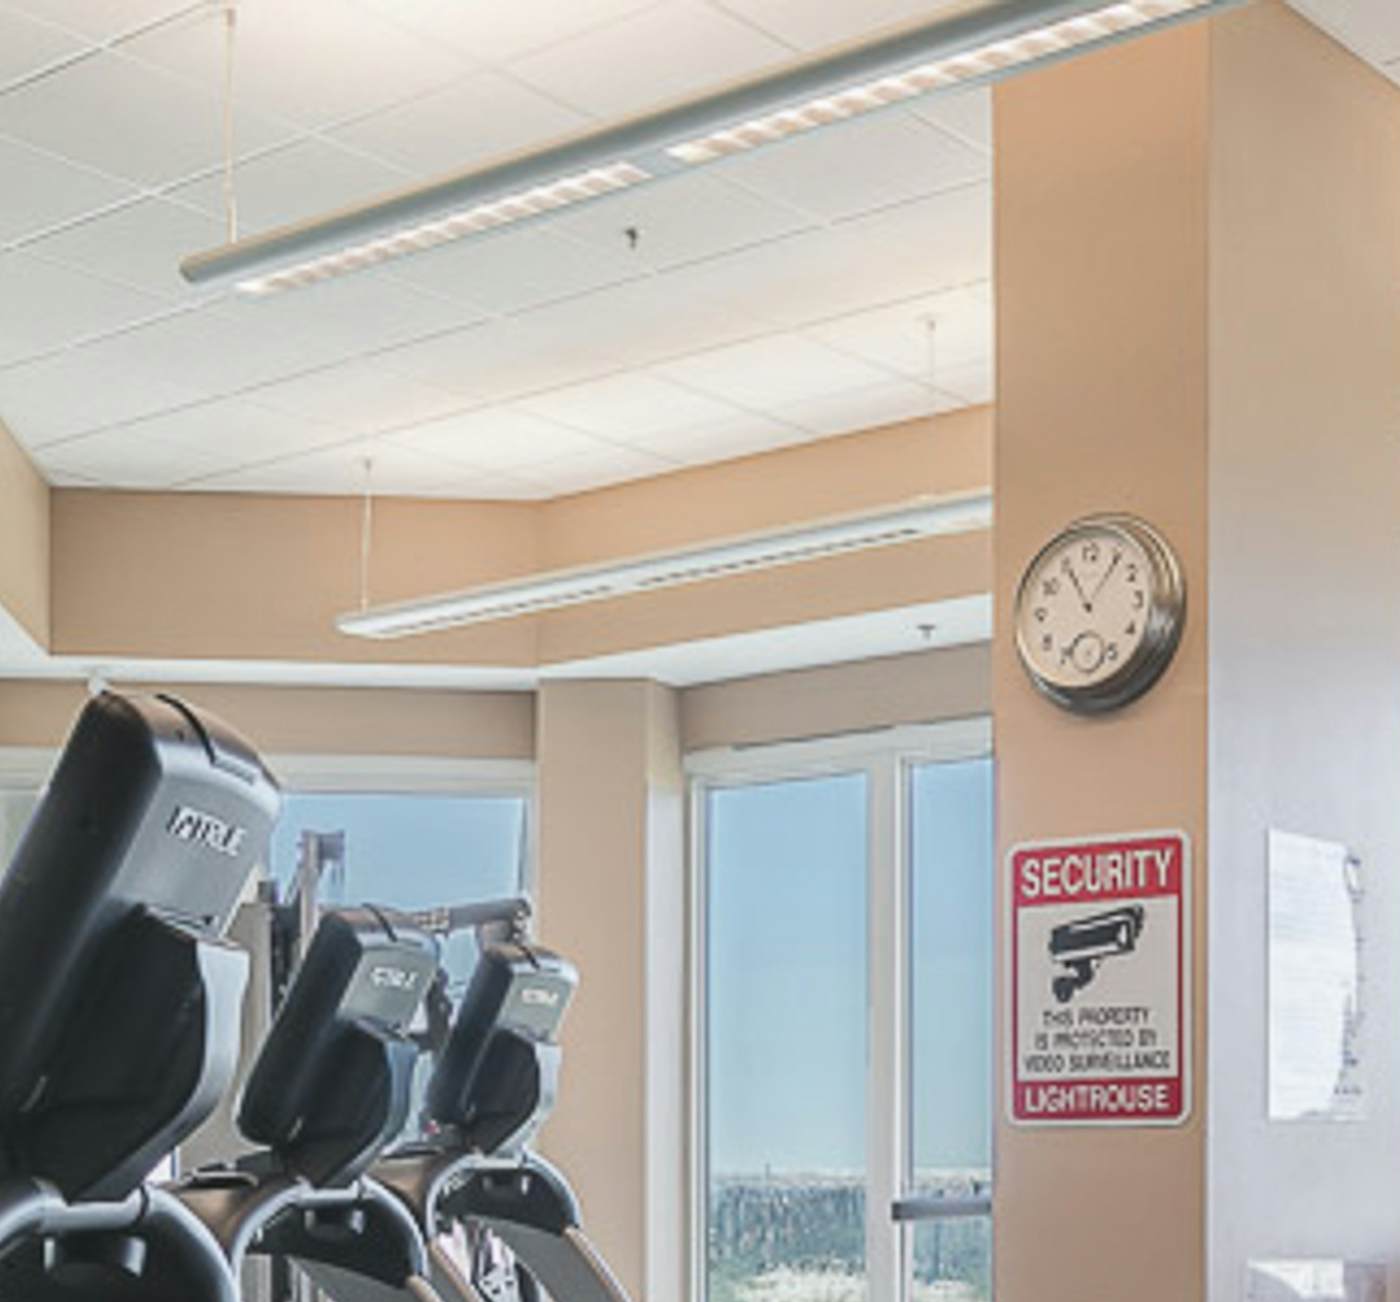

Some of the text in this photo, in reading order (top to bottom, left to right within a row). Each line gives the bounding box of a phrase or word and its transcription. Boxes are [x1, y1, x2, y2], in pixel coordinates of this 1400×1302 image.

[1083, 543, 1098, 562] 12
[1127, 563, 1137, 582] 2
[1133, 590, 1144, 609] 3
[1125, 620, 1136, 635] 4
[1021, 848, 1174, 898] SECURITY
[1043, 1006, 1150, 1027] THIS PROPERTY
[1034, 1028, 1157, 1050] IS PROTECTED BY
[1024, 1050, 1171, 1073] VIDEO SURVEILLANCE
